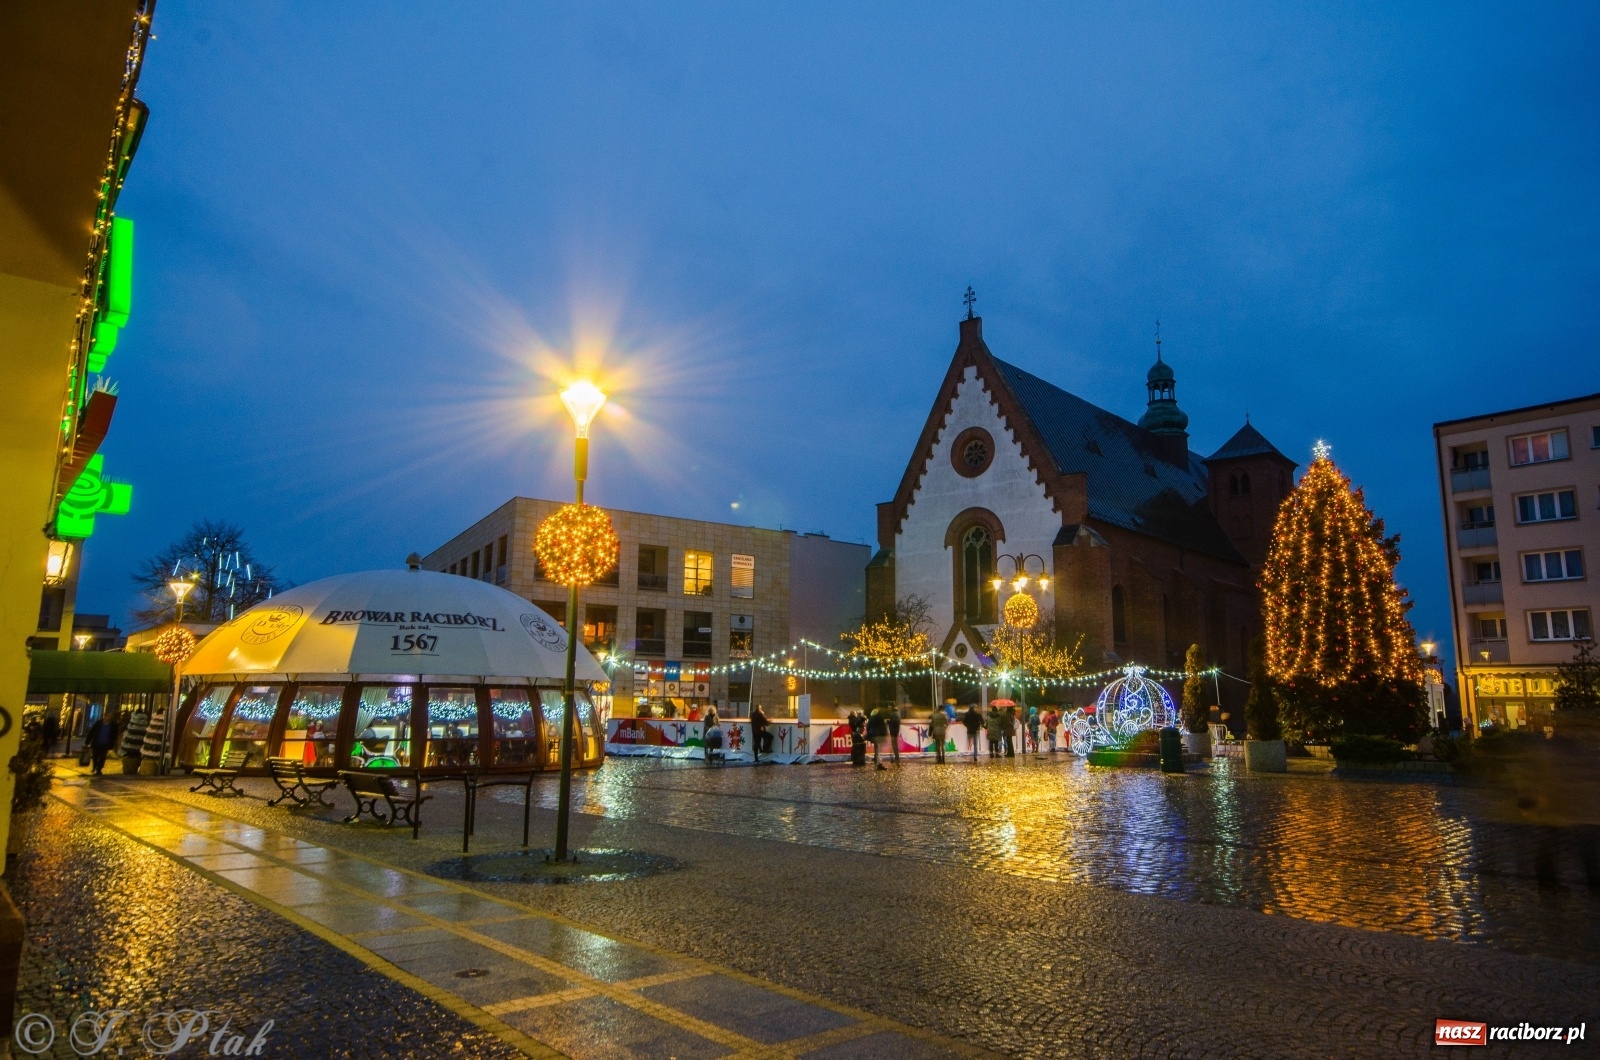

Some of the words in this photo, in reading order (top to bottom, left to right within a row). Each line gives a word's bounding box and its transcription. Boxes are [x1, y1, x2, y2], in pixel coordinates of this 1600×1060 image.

[319, 610, 405, 625] BROWAR
[410, 612, 505, 632] RACIBÓRZ
[390, 633, 438, 652] 1567
[620, 727, 645, 739] mBank
